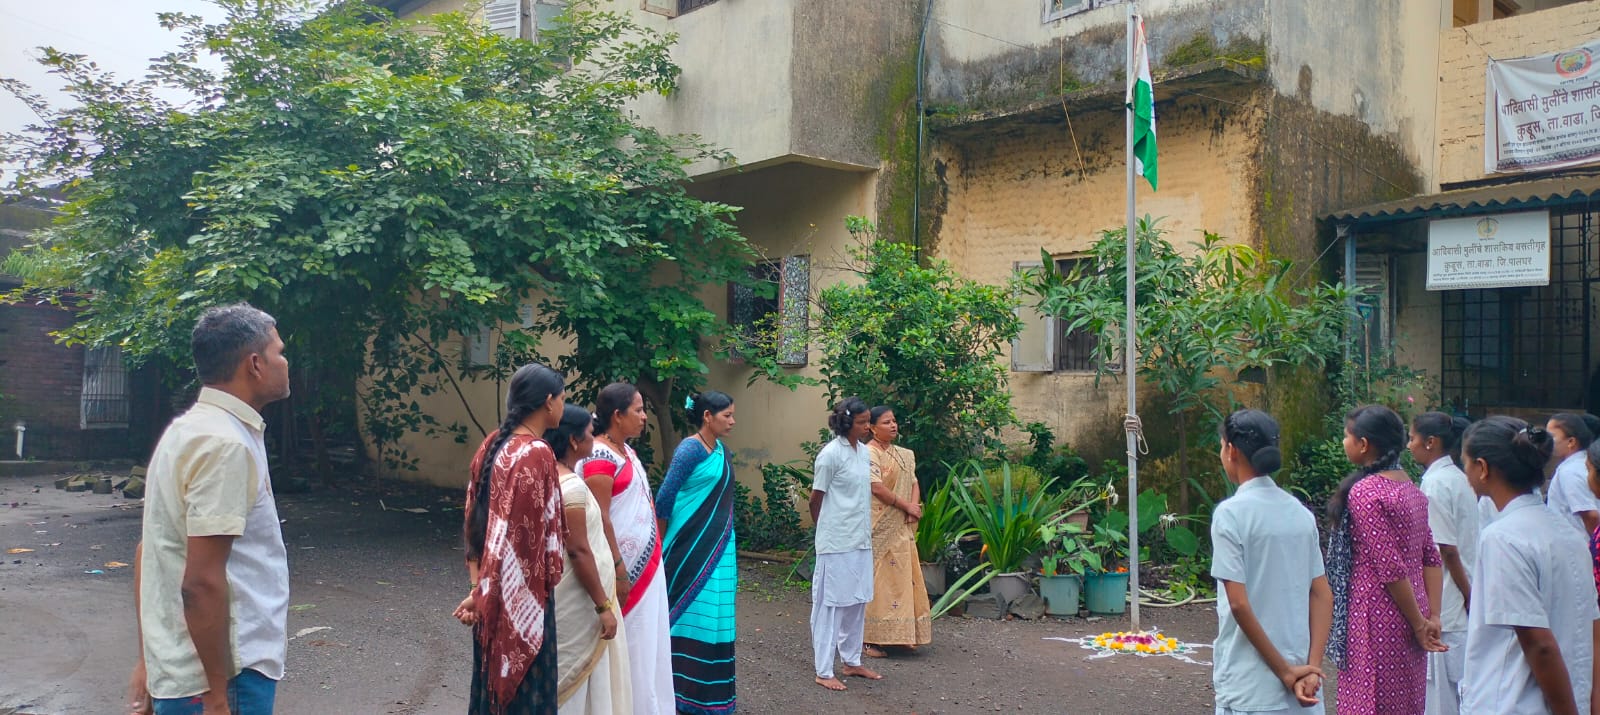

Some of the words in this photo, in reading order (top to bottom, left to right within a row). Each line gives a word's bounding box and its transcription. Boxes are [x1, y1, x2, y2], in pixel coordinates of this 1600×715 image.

[1541, 88, 1569, 113] मुलींचे
[1432, 243, 1462, 256] आदिवासी
[1464, 243, 1481, 257] मुलींचे
